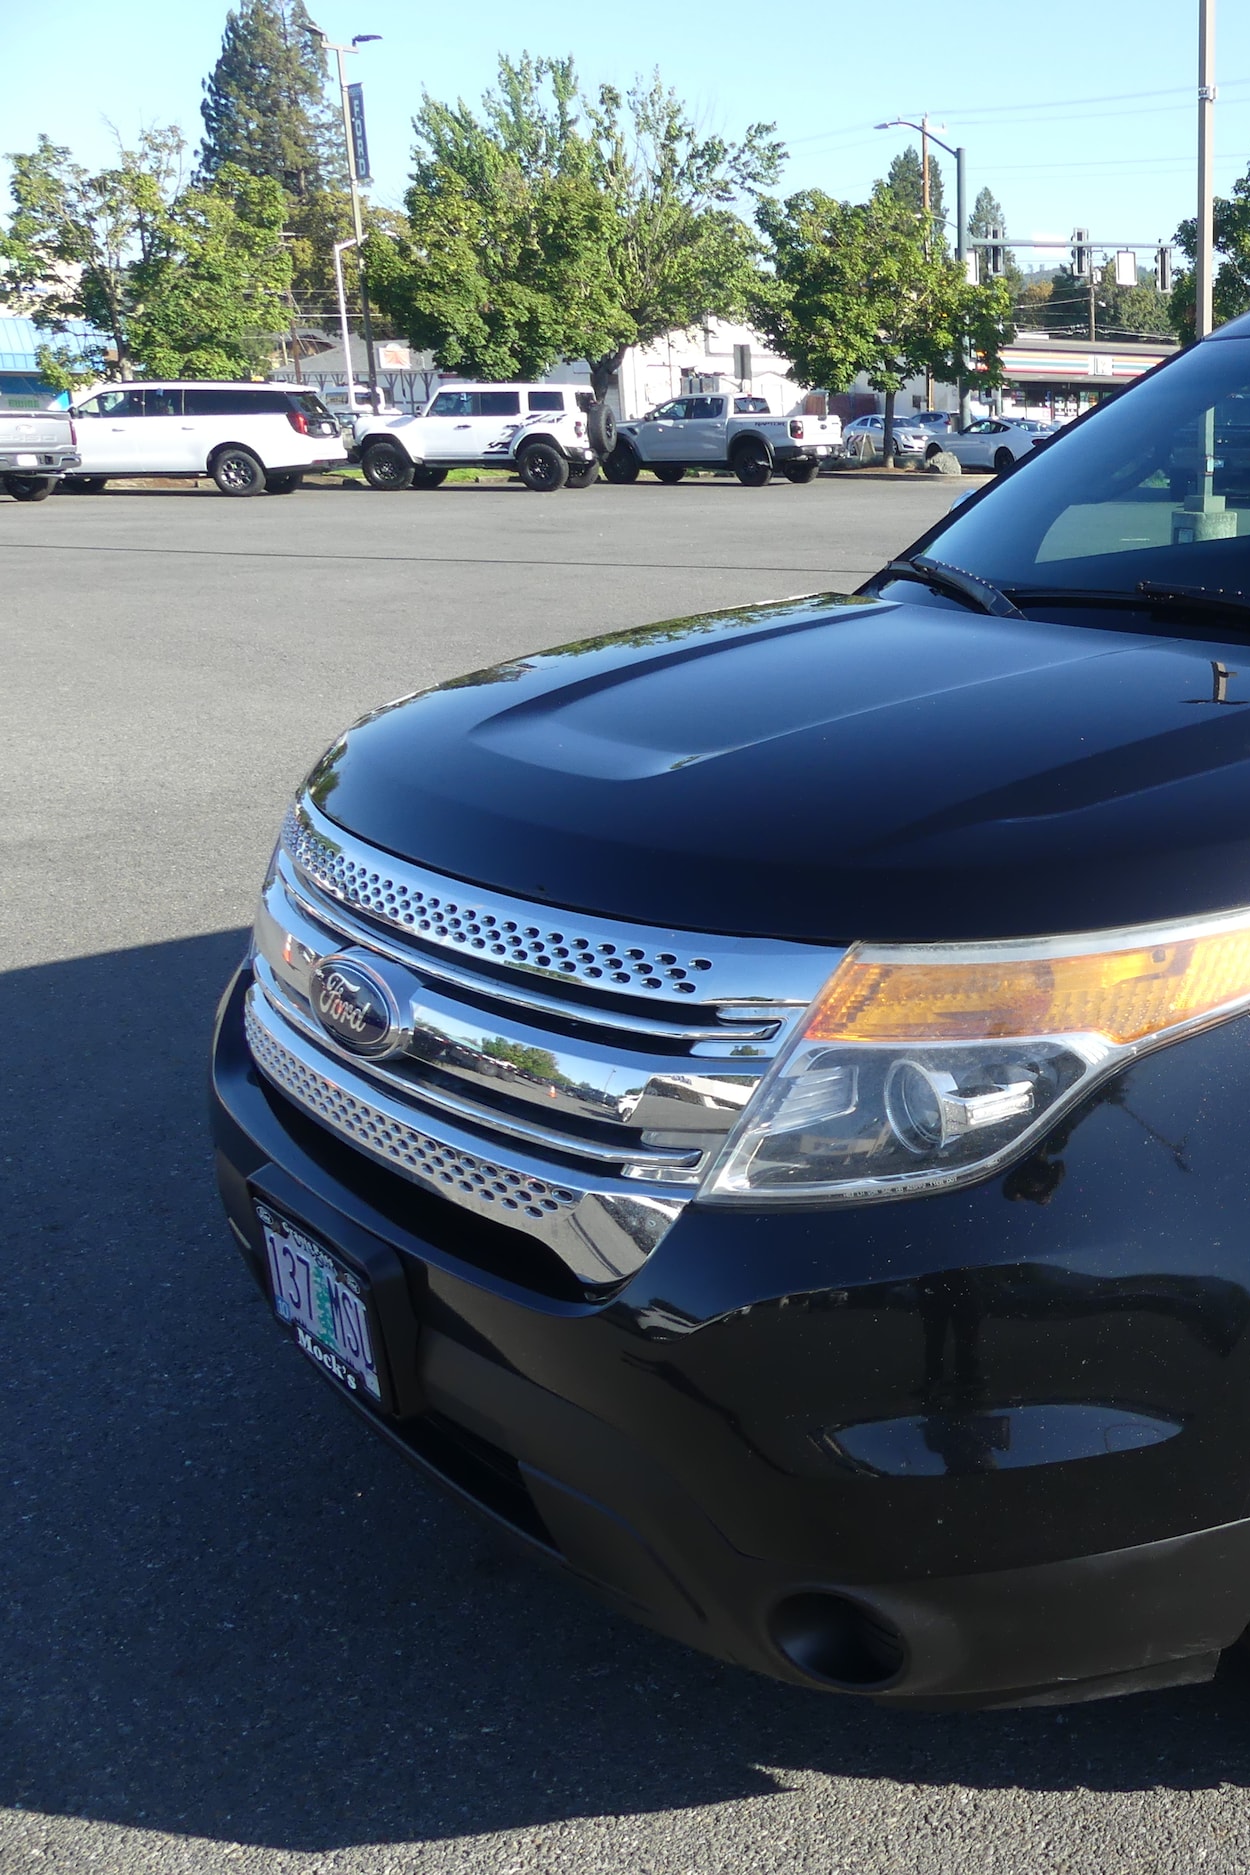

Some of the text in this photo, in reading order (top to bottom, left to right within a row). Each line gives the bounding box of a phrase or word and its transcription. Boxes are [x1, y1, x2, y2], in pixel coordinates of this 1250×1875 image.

[353, 99, 366, 176] FORD
[319, 972, 371, 1032] Ford
[269, 1234, 314, 1320] 137
[326, 1276, 375, 1370] MSU
[298, 1328, 357, 1390] Mock's
